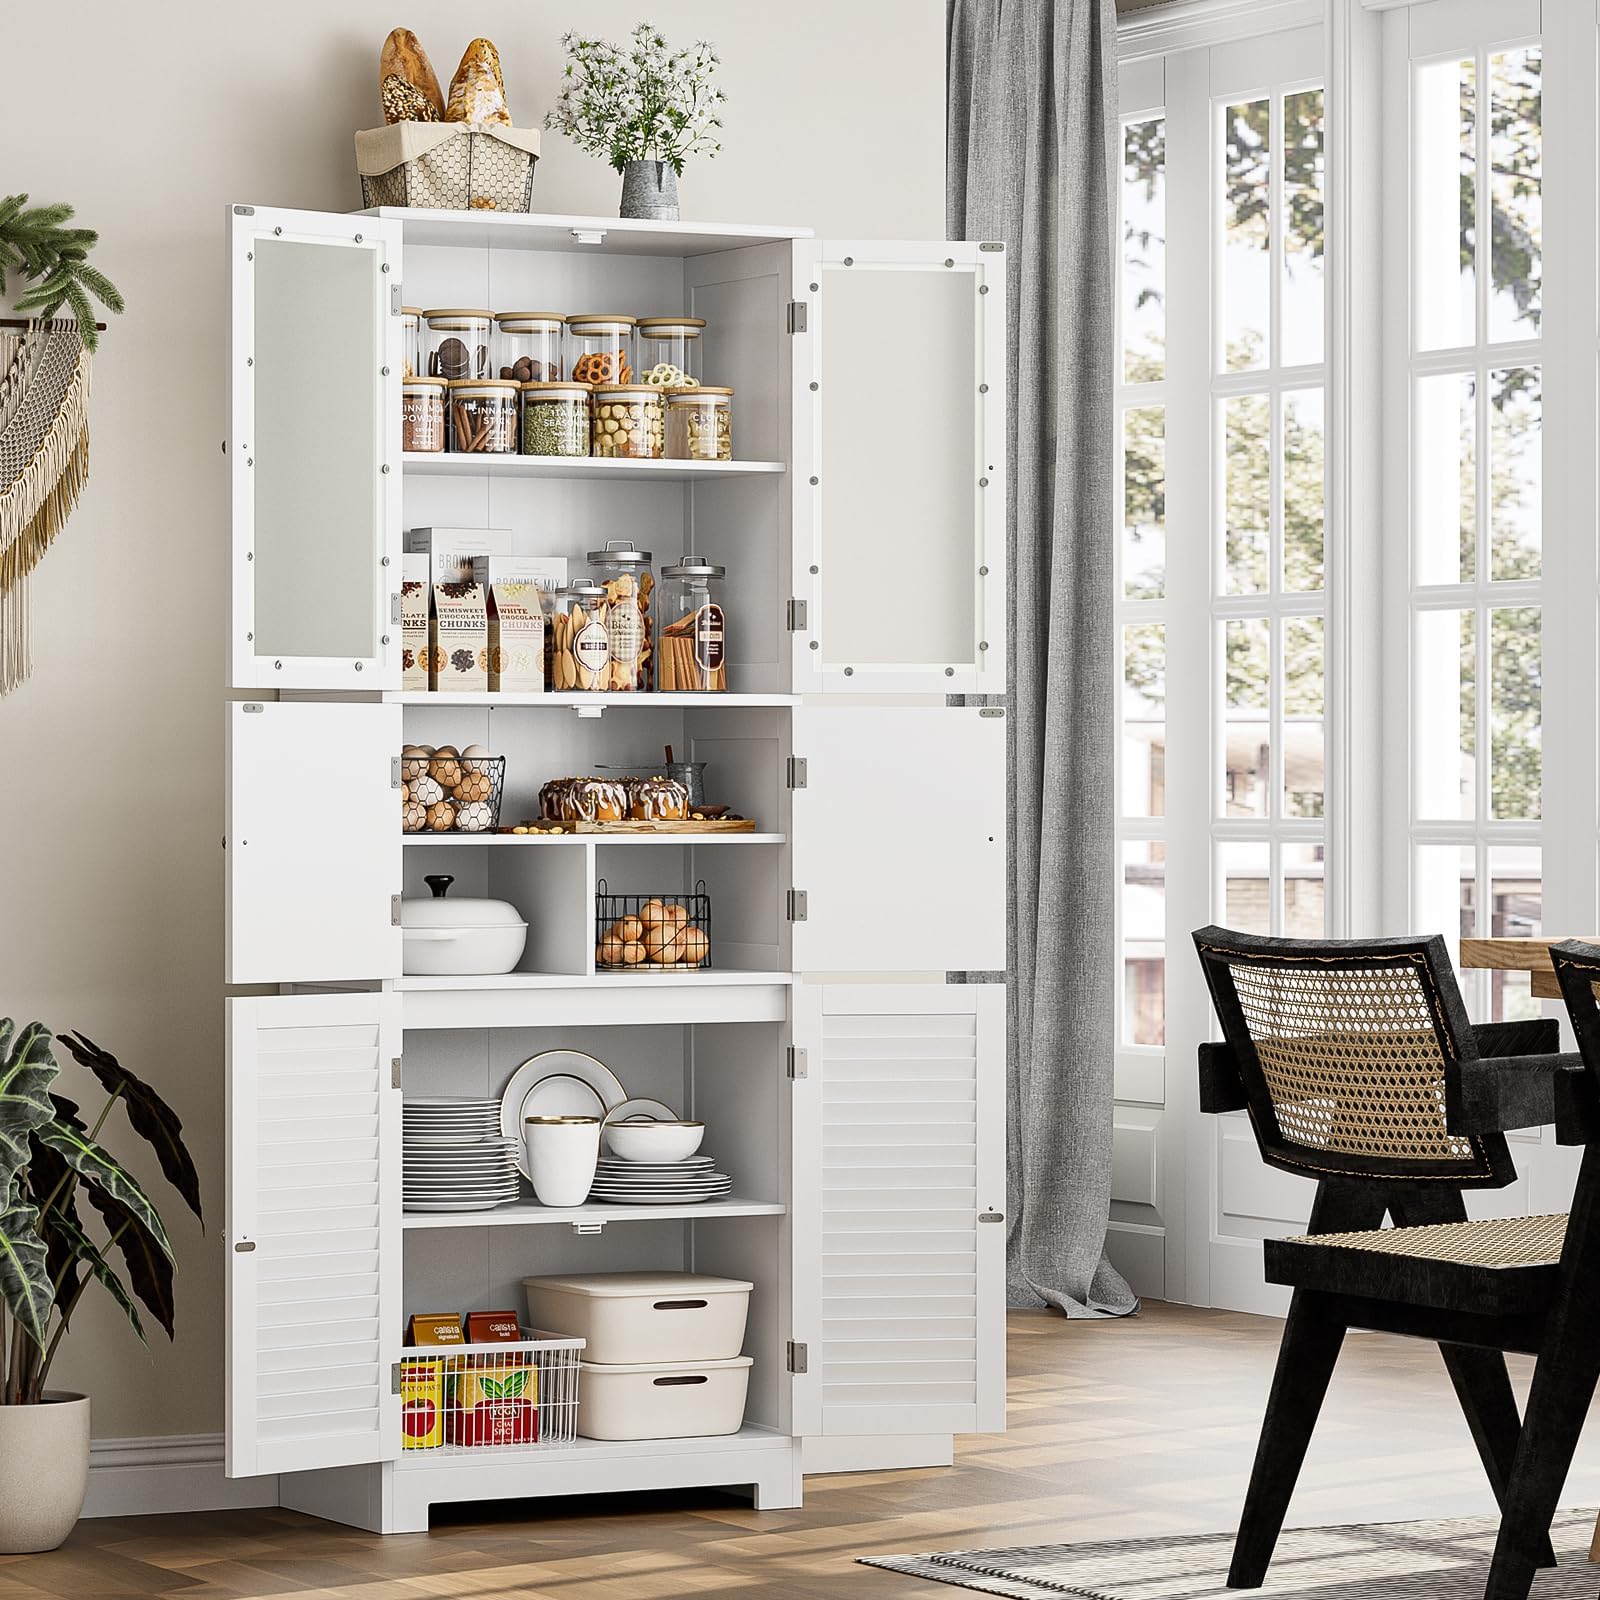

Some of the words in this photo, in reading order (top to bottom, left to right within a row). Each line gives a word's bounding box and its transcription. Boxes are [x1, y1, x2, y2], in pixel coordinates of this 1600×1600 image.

[695, 423, 728, 431] HOEY
[439, 553, 473, 569] BROWN
[543, 578, 560, 591] MIX
[402, 619, 427, 627] NKS
[440, 620, 486, 628] CHUNKS
[502, 621, 543, 629] CHUNKS
[494, 1427, 514, 1436] SPC
